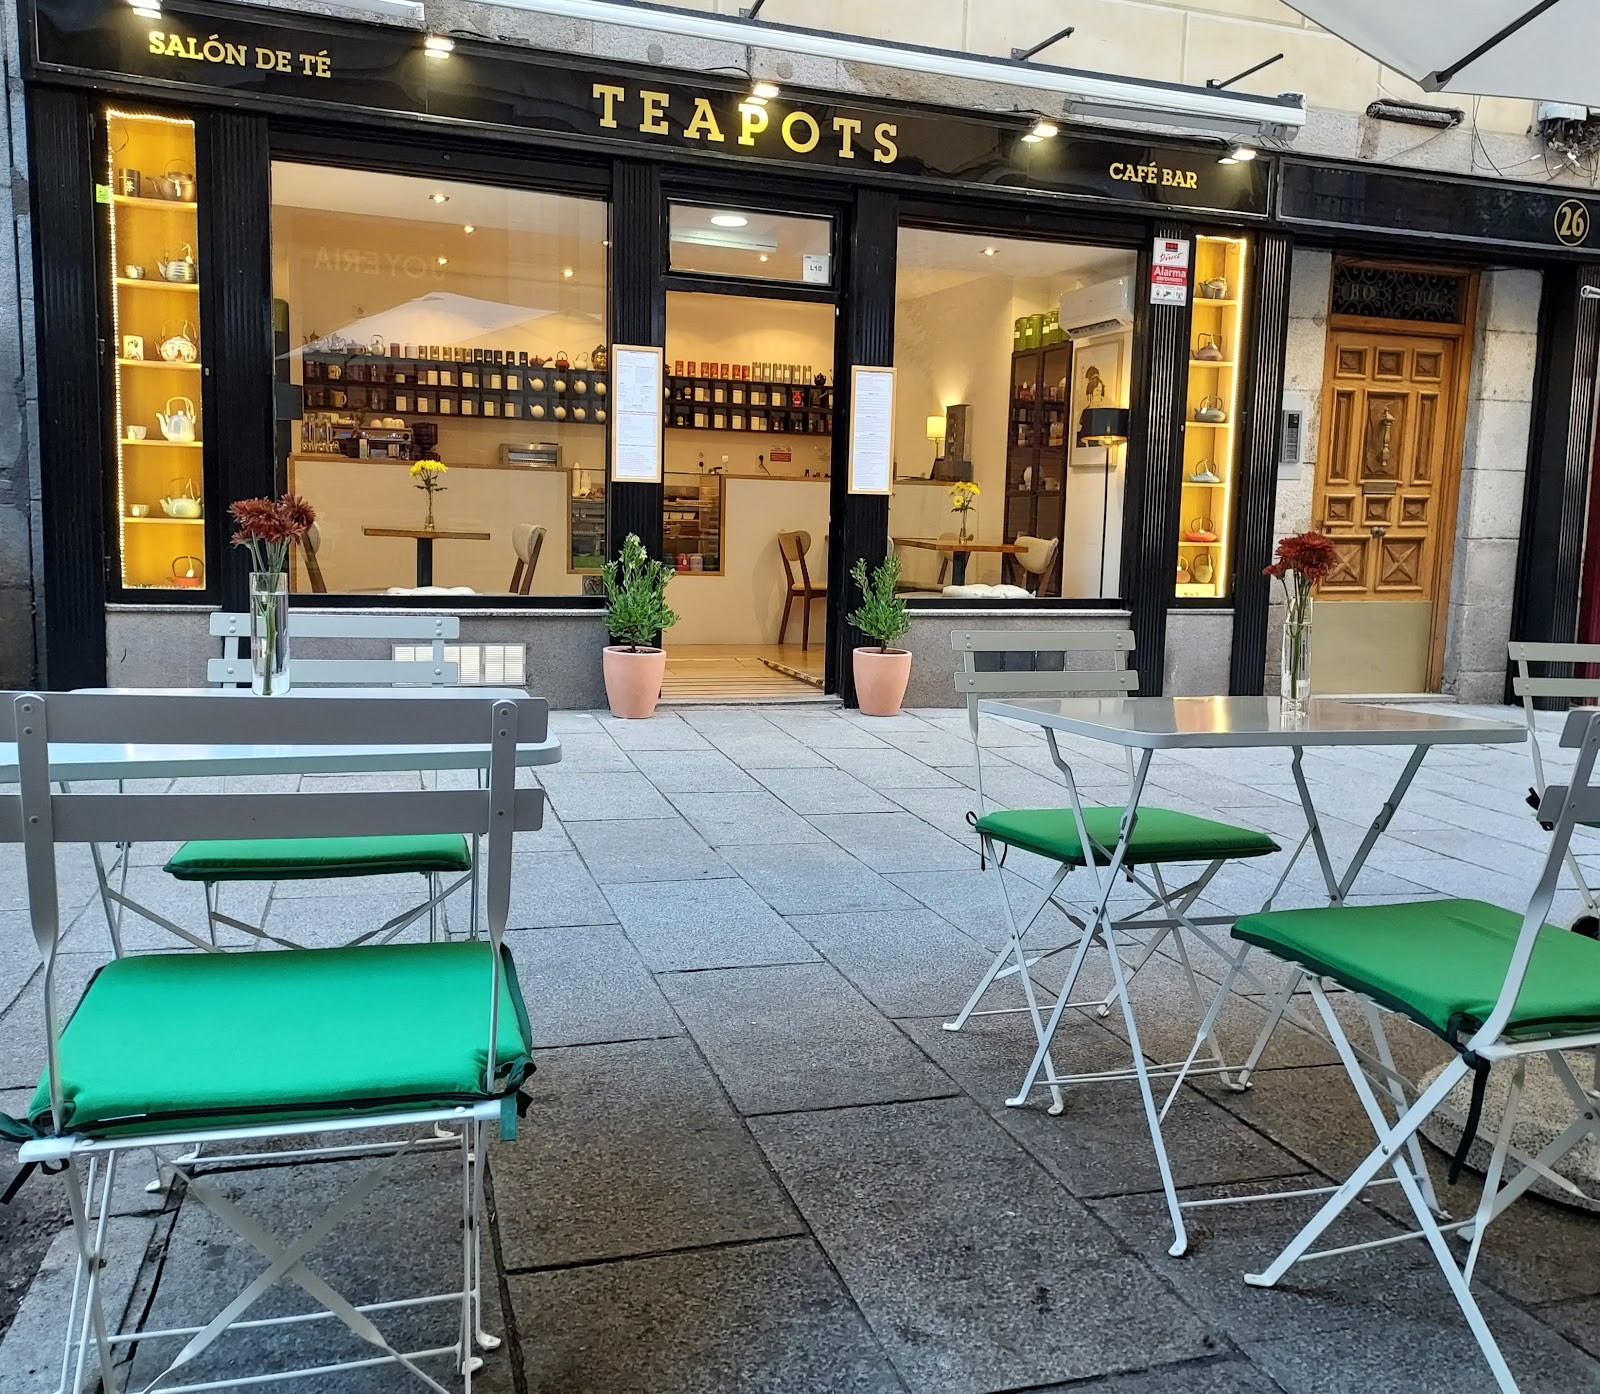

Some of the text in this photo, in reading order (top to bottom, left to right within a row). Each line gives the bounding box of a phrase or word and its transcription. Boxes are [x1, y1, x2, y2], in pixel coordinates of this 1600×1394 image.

[148, 34, 332, 78] SALÓN DE TÉ
[592, 83, 898, 164] TEAPOTS
[1109, 161, 1198, 189] CAFÉ BAR
[1559, 206, 1585, 238] 26
[1154, 266, 1187, 278] Alarma
